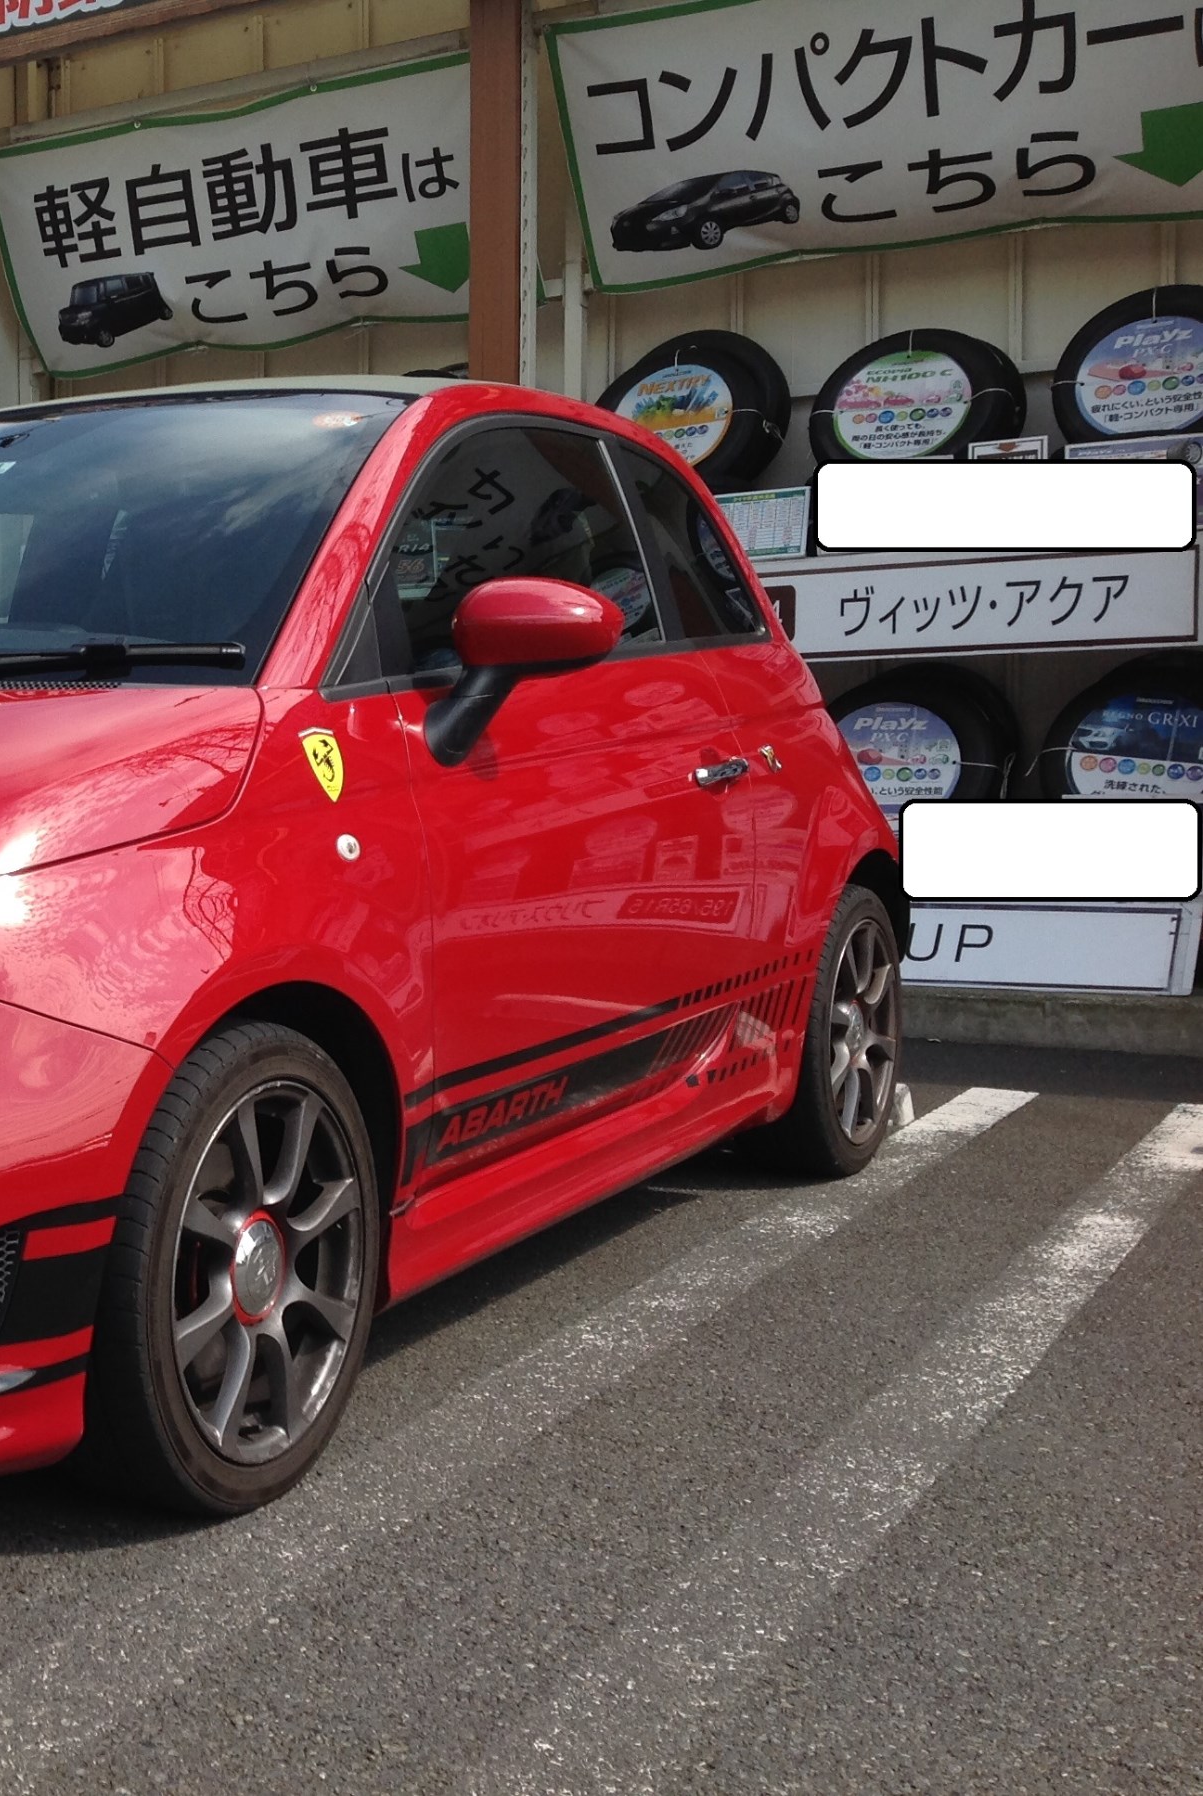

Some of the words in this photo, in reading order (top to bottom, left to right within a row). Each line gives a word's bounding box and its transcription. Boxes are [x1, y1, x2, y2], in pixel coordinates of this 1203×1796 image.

[586, 0, 1203, 155] コンパクトカー
[33, 126, 460, 269] 軽自動車は
[817, 130, 1096, 224] こちら
[184, 246, 389, 325] こちら
[839, 574, 1130, 636] ヴィッツ・アクア
[904, 923, 994, 962] UP
[436, 1075, 568, 1152] ABARTH
